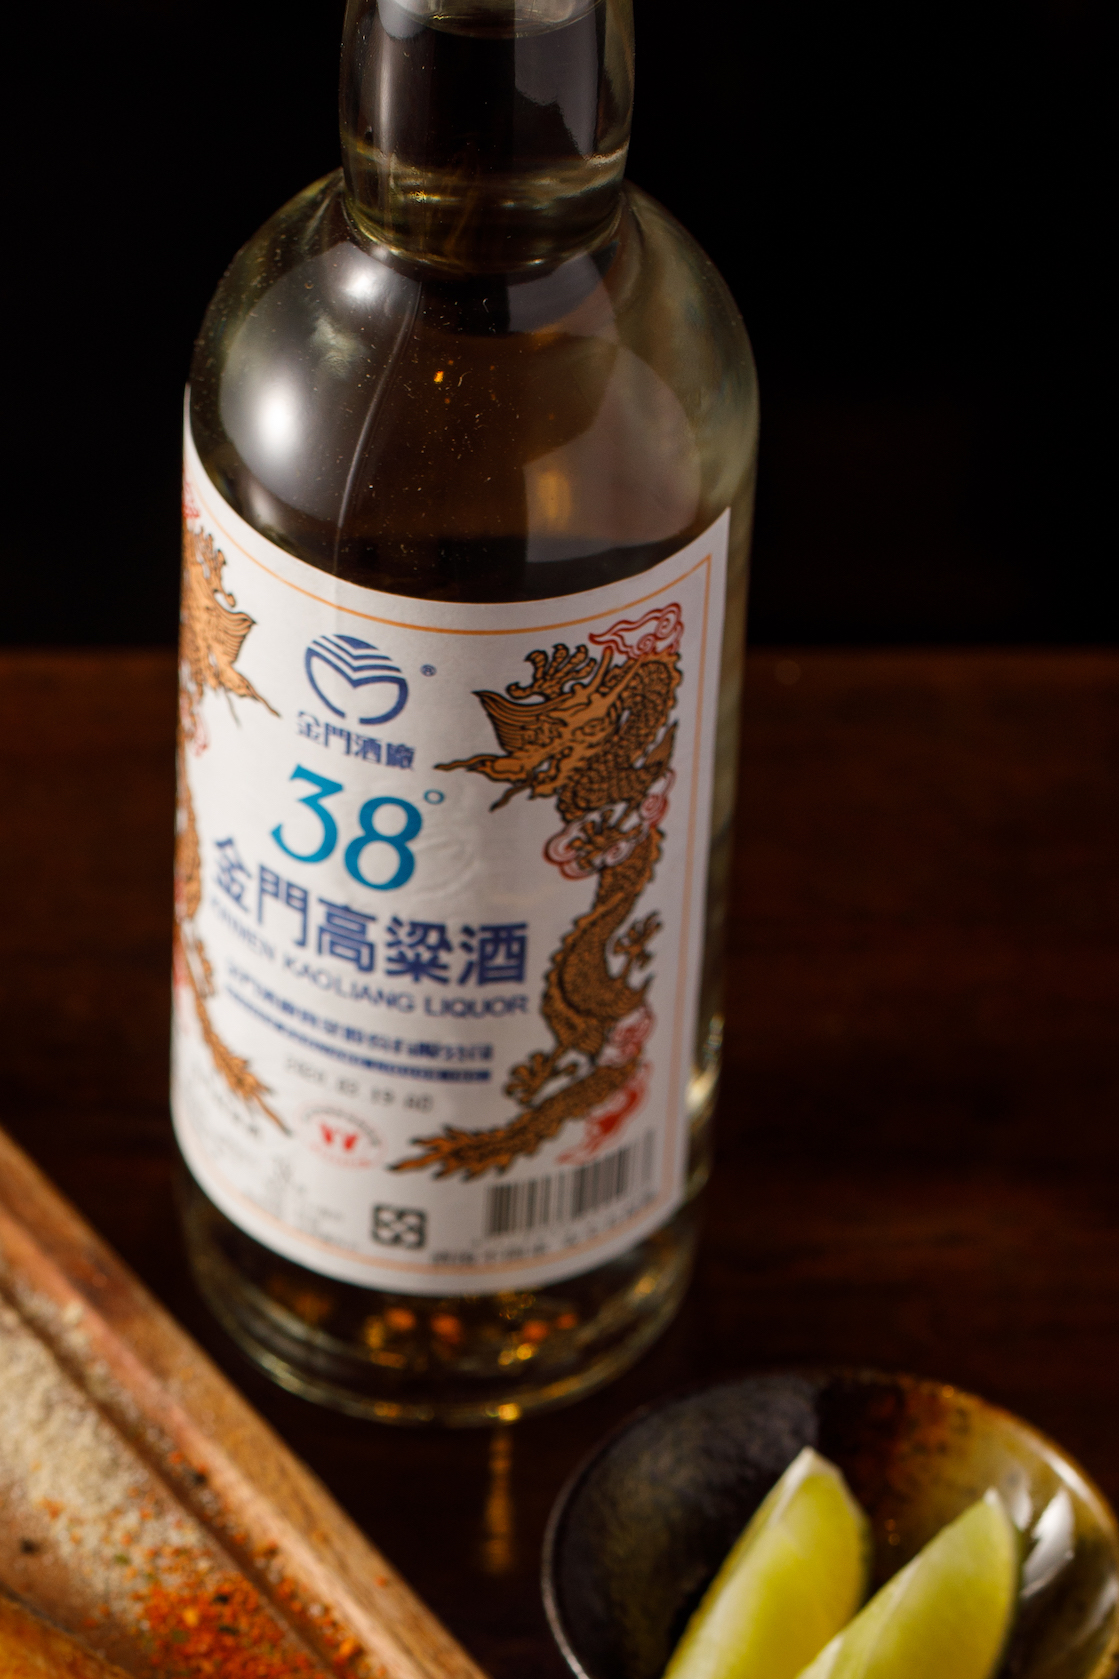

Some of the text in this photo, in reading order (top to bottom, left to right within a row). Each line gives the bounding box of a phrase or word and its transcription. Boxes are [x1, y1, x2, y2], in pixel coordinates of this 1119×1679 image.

[213, 837, 529, 987] 金門高粱酒
[284, 953, 415, 1014] KAOLIANG
[424, 993, 528, 1019] LIQUOR
